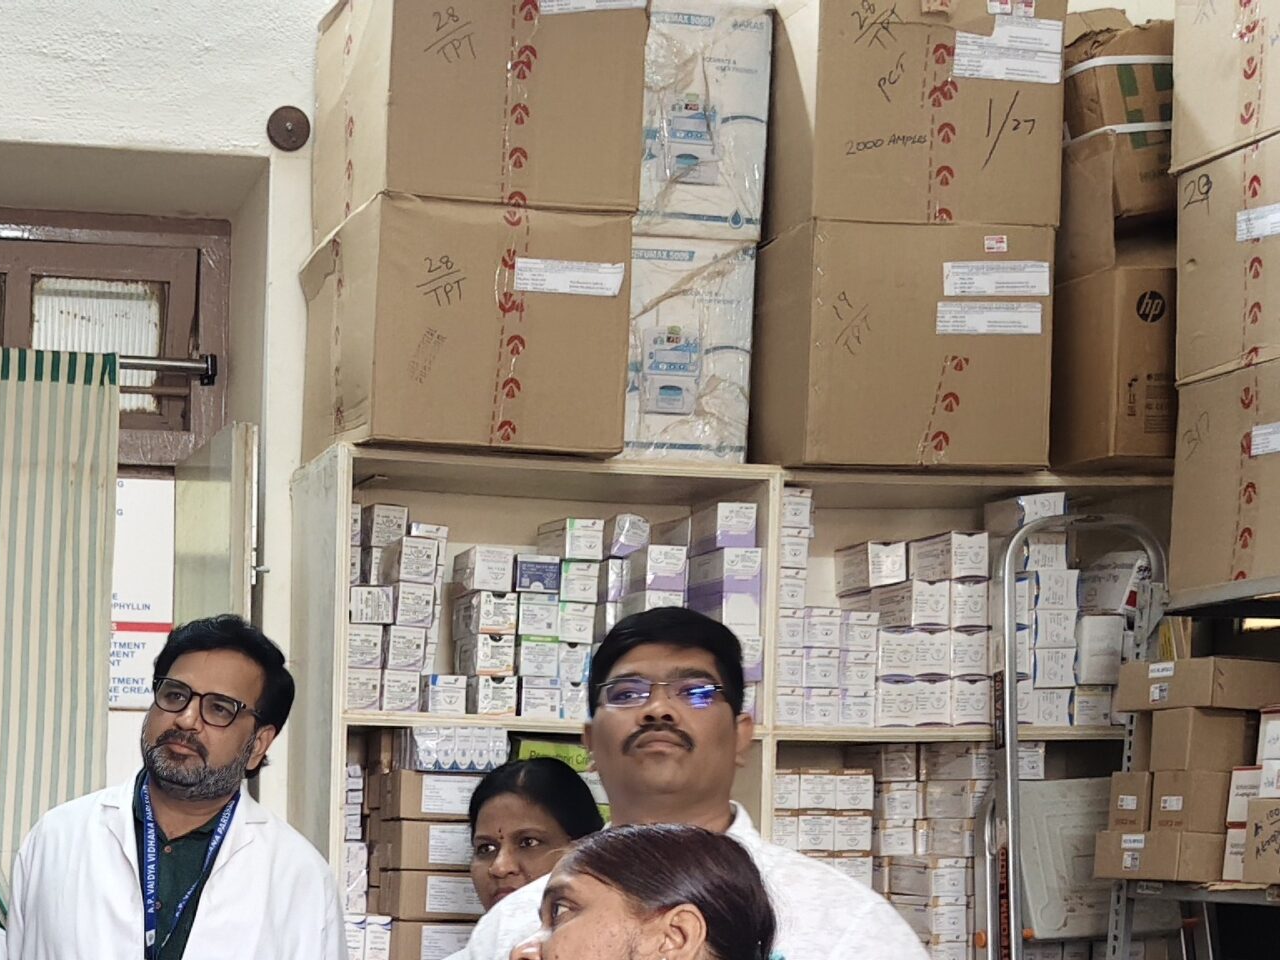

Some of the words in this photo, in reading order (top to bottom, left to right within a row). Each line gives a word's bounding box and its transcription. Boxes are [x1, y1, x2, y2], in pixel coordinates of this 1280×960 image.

[110, 642, 146, 650] TMENT
[110, 677, 145, 685] TMENT
[146, 821, 156, 860] VIDHANA
[146, 863, 156, 894] VAIDYA
